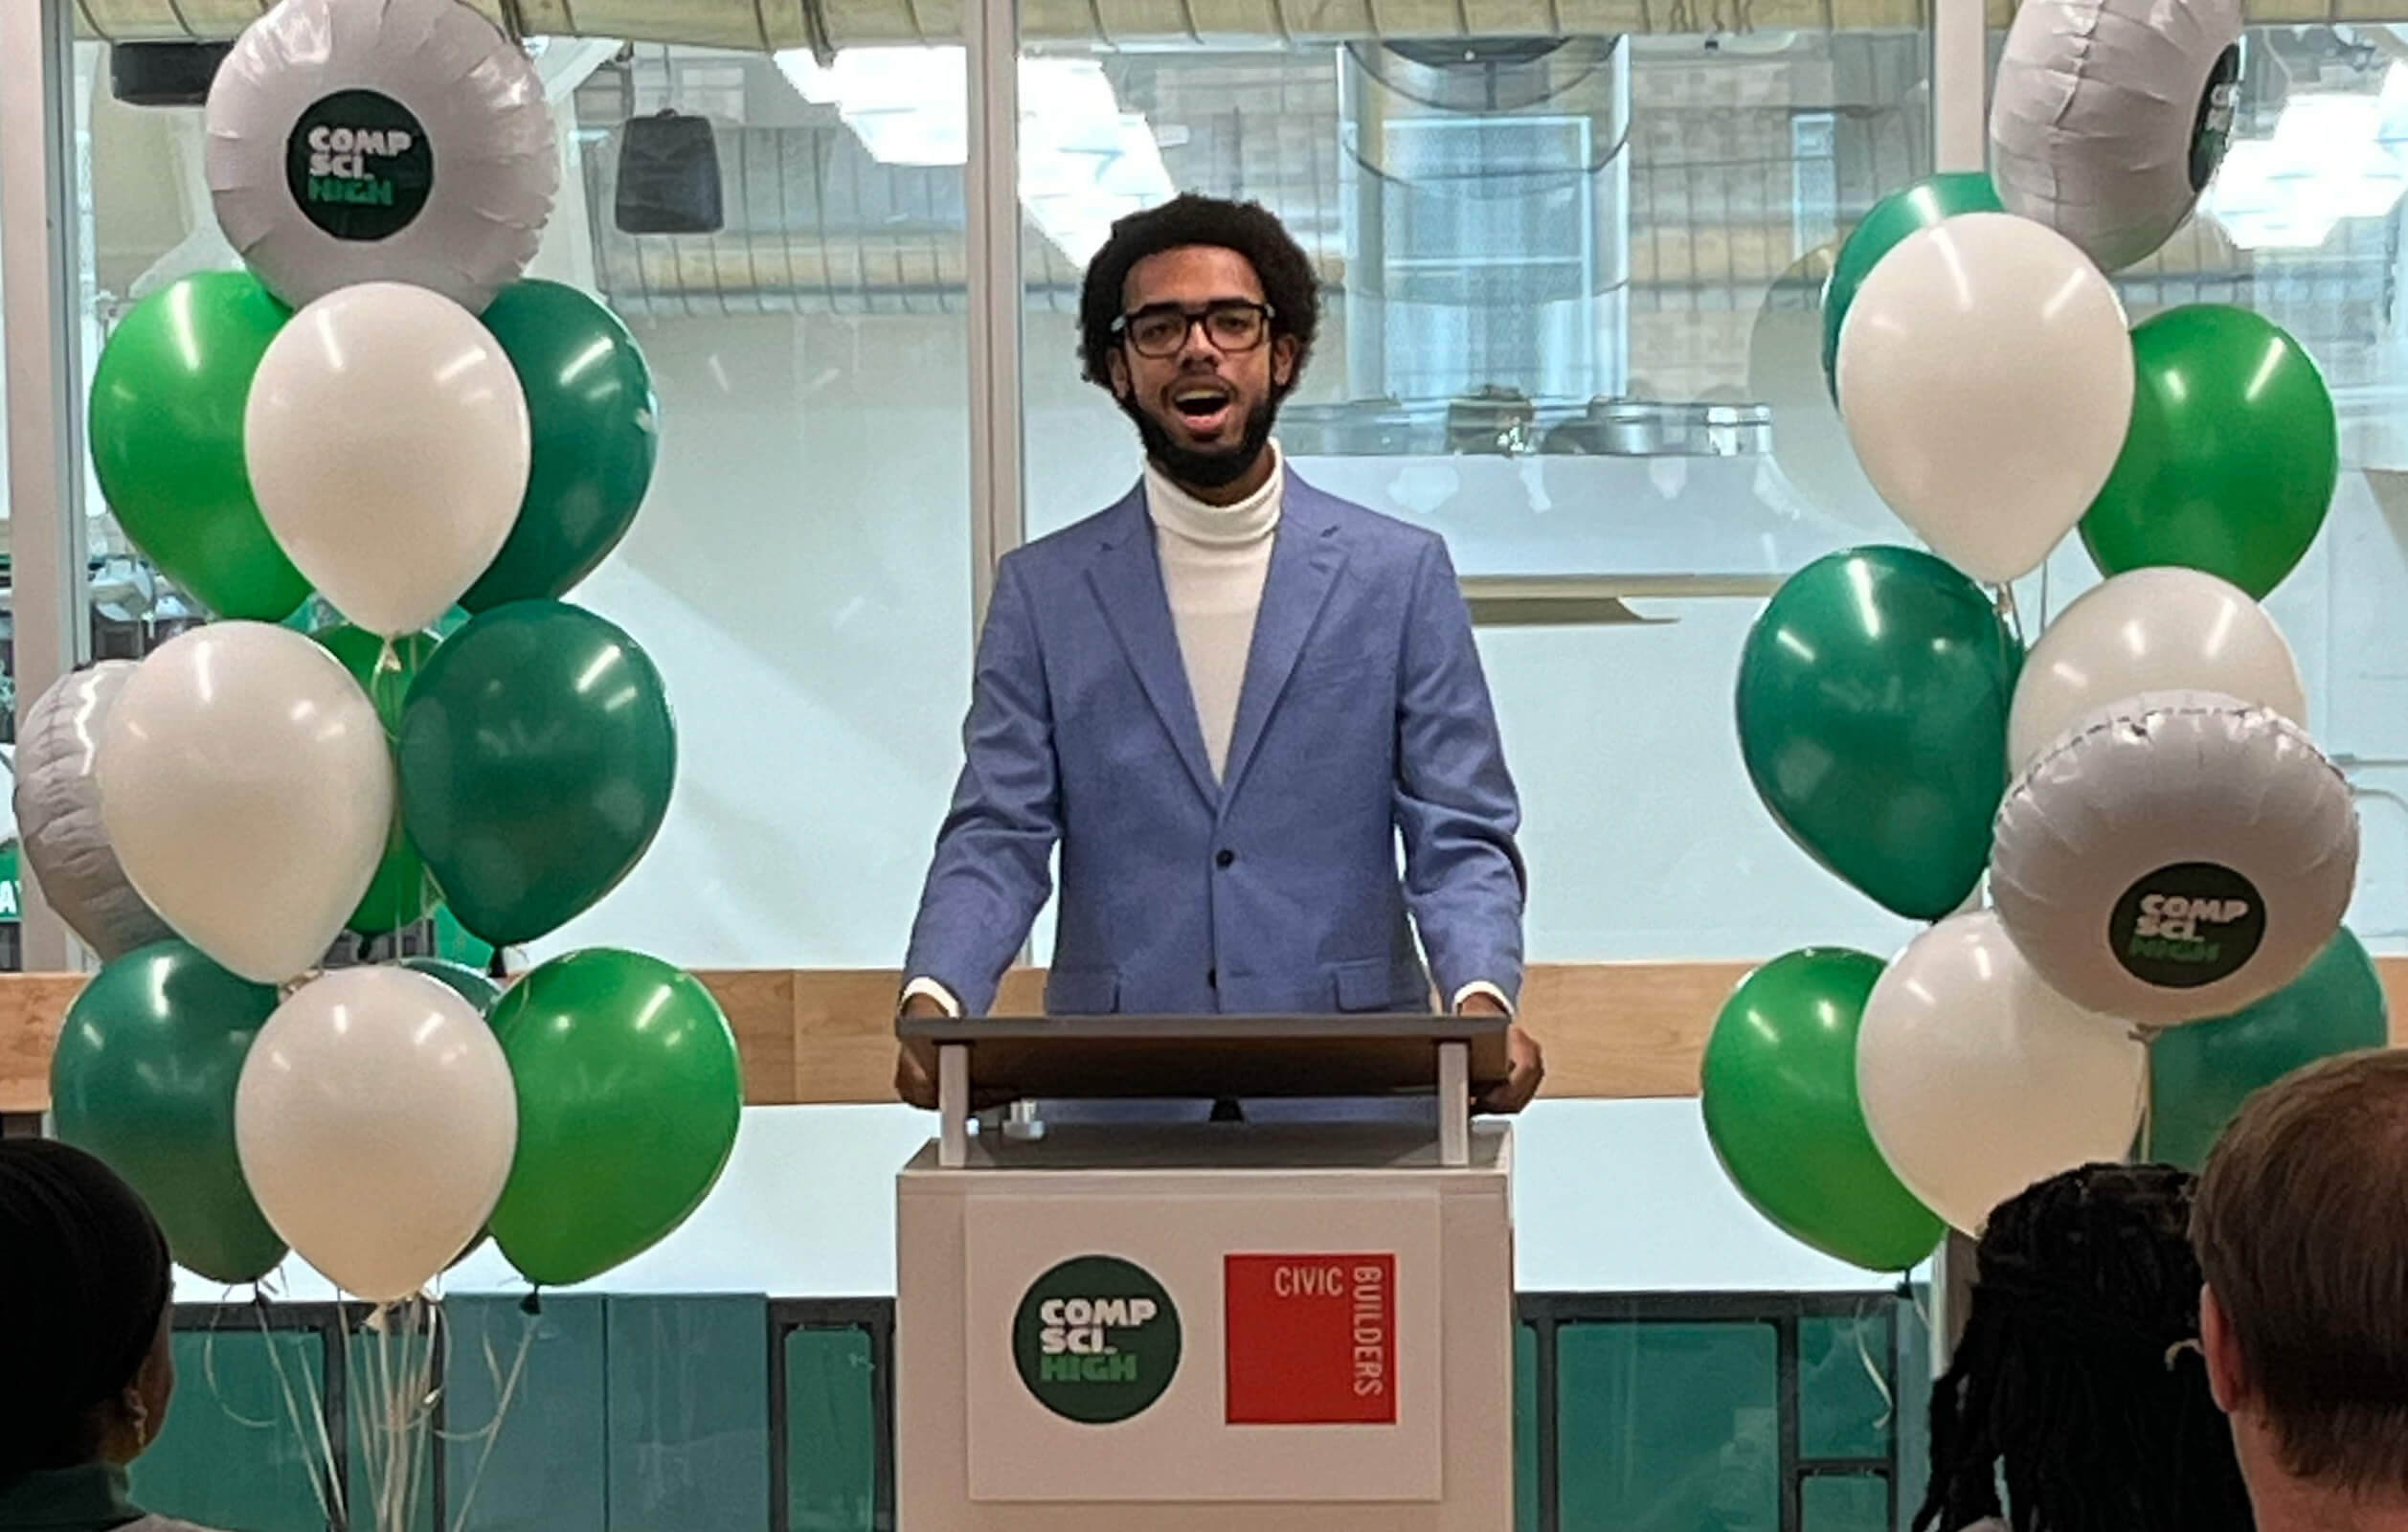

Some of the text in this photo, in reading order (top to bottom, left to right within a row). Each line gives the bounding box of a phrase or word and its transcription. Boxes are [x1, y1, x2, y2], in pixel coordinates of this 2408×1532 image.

[308, 126, 412, 156] COMP
[2141, 893, 2248, 923] COMP
[1274, 1266, 1343, 1297] CIVIC
[1040, 1297, 1157, 1326] COMP
[1353, 1266, 1383, 1396] BUILDERS
[1041, 1354, 1137, 1382] HIGH
